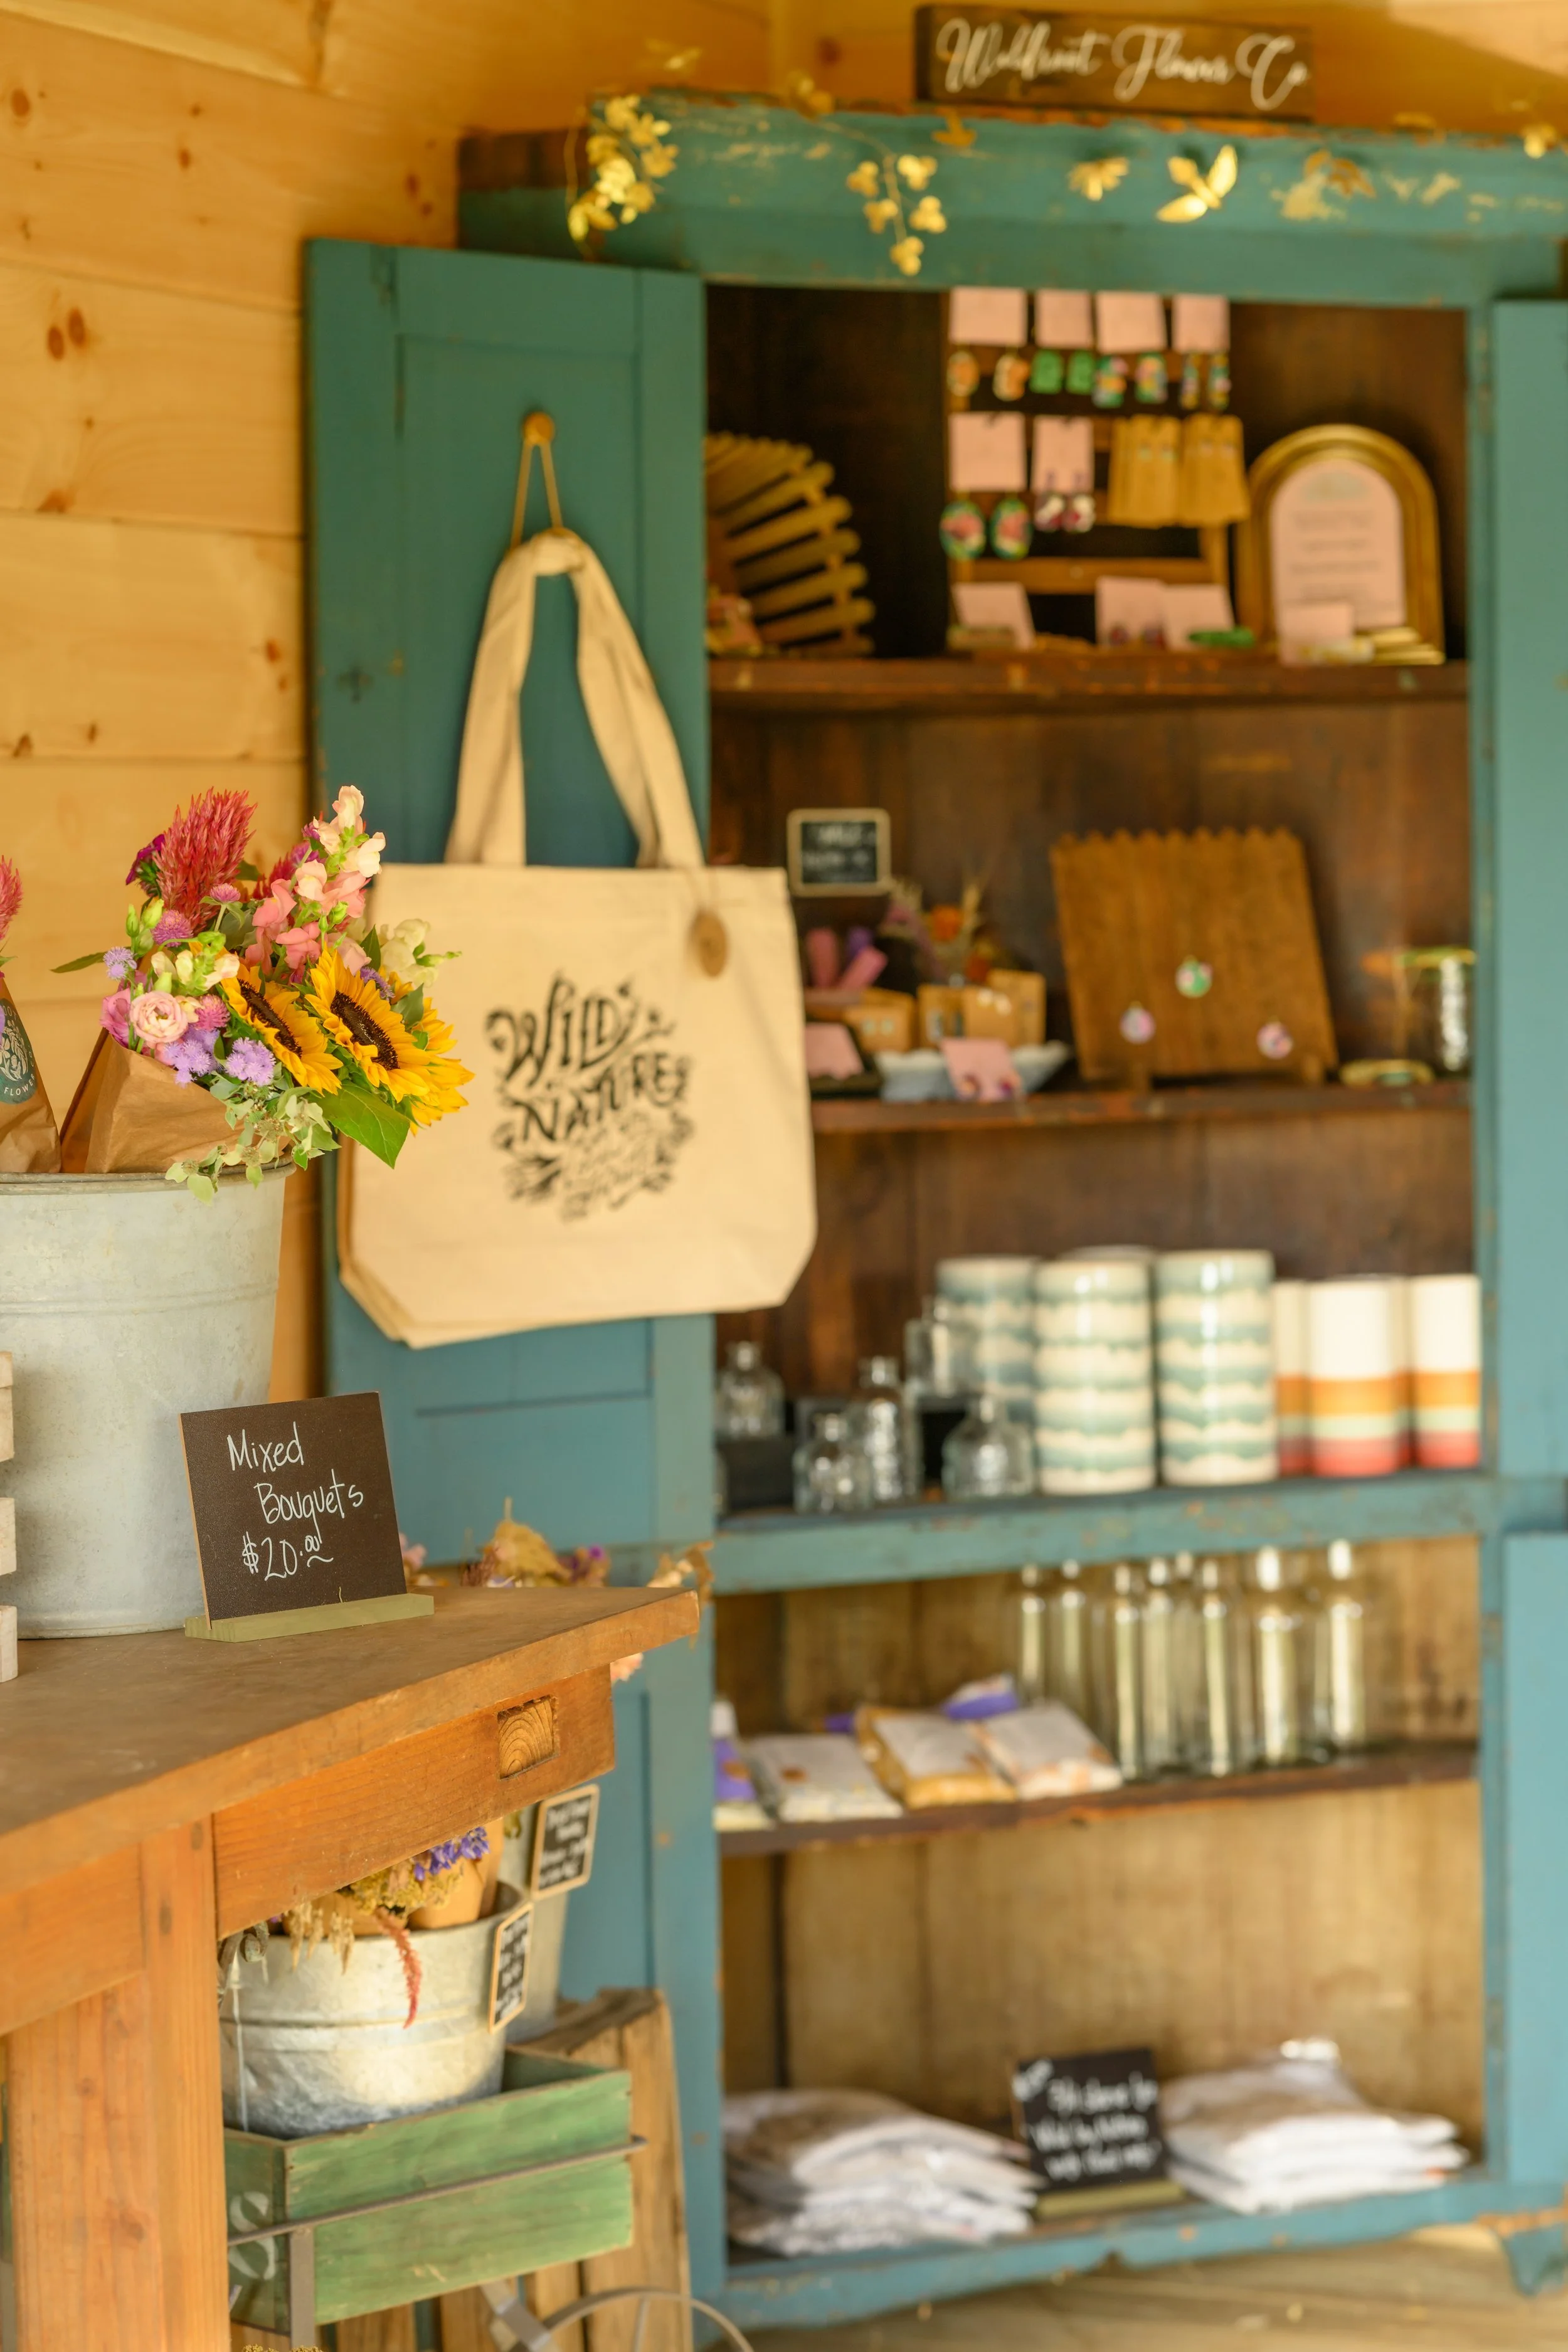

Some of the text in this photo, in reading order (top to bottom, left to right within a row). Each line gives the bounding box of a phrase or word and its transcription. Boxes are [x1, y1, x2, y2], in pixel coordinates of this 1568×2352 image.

[4, 1073, 35, 1096] FLOWER
[227, 1421, 304, 1473] Mixed
[253, 1468, 364, 1544] Bouquets
